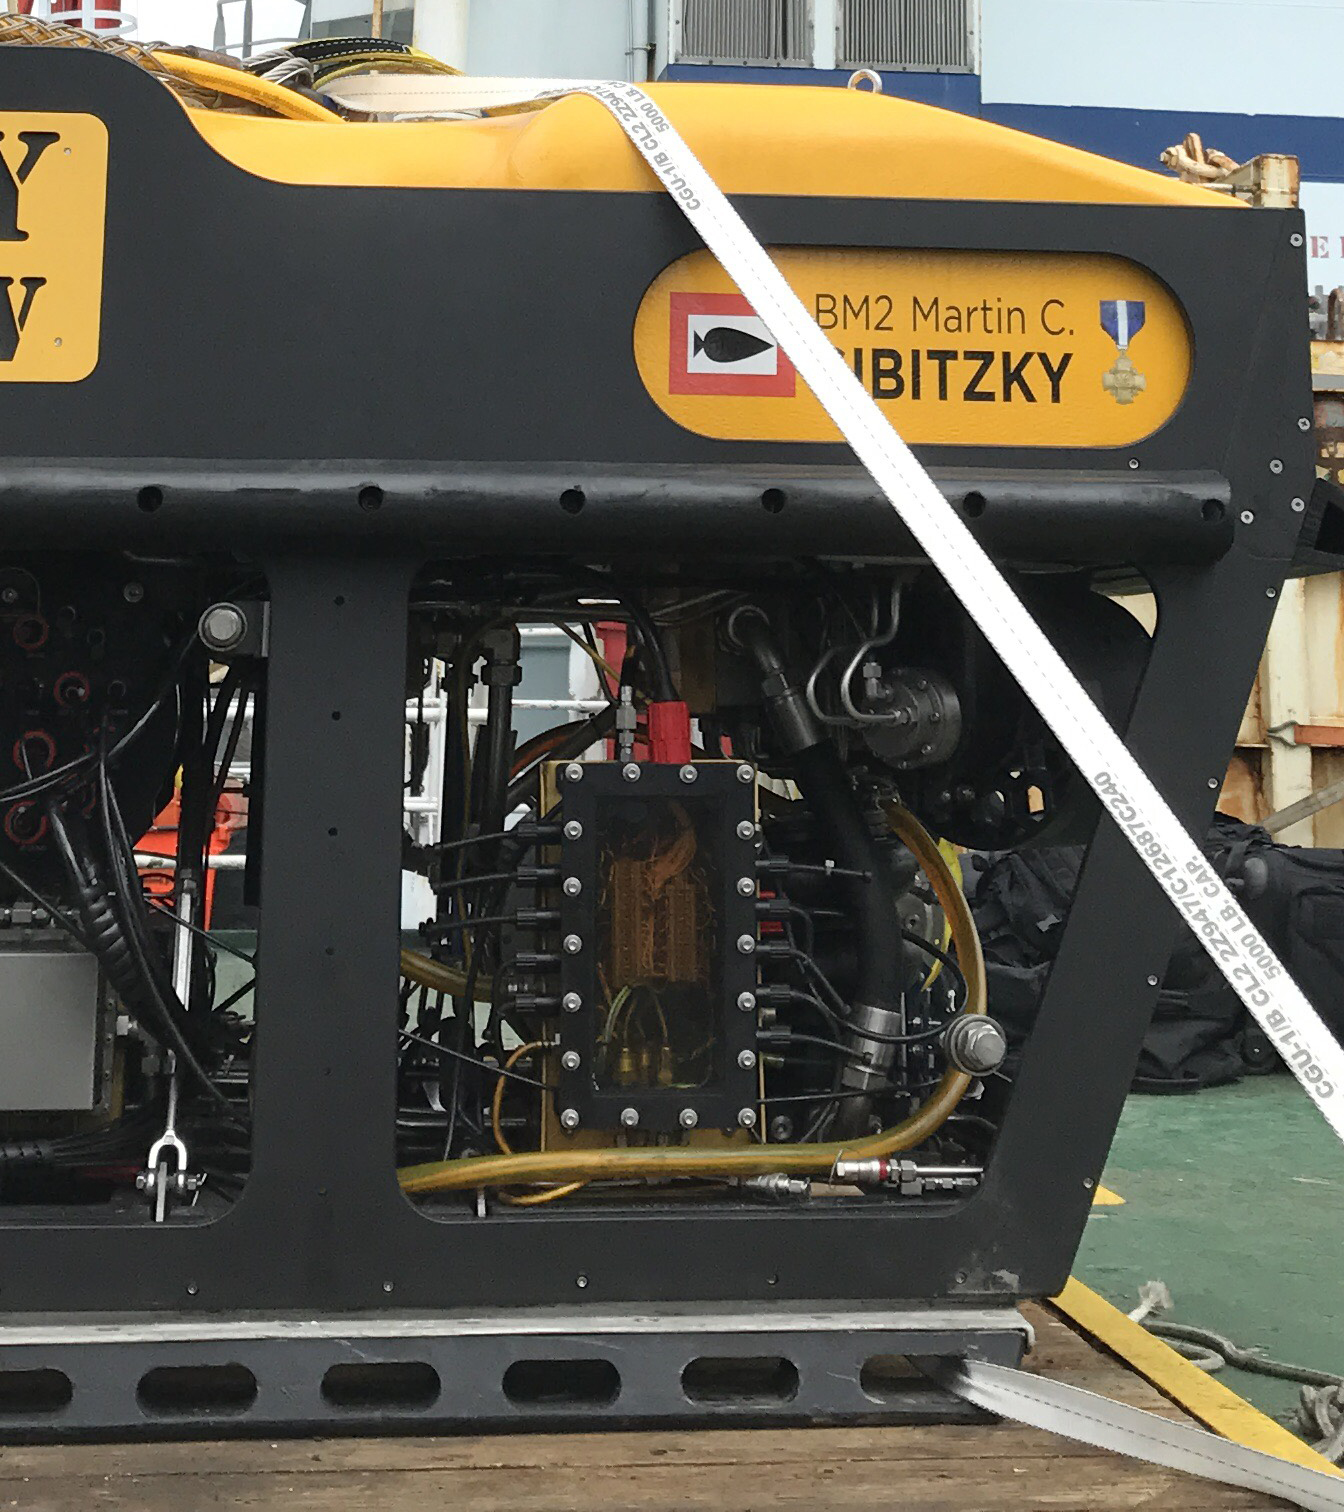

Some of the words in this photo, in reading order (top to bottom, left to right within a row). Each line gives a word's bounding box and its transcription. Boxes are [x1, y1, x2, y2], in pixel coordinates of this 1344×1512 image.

[631, 120, 659, 152] CL2
[640, 102, 670, 134] 5000
[653, 151, 702, 212] CGU-1/B
[814, 292, 895, 332] BM2
[911, 295, 1027, 336] Martin
[1040, 298, 1075, 337] C.
[836, 346, 1074, 404] IBITZKY
[1184, 855, 1221, 898] CAP.
[1219, 899, 1247, 933] LB.
[1241, 932, 1282, 980] 5000
[1231, 962, 1271, 1008] CL2
[1265, 1008, 1336, 1100] CGU-1/B
